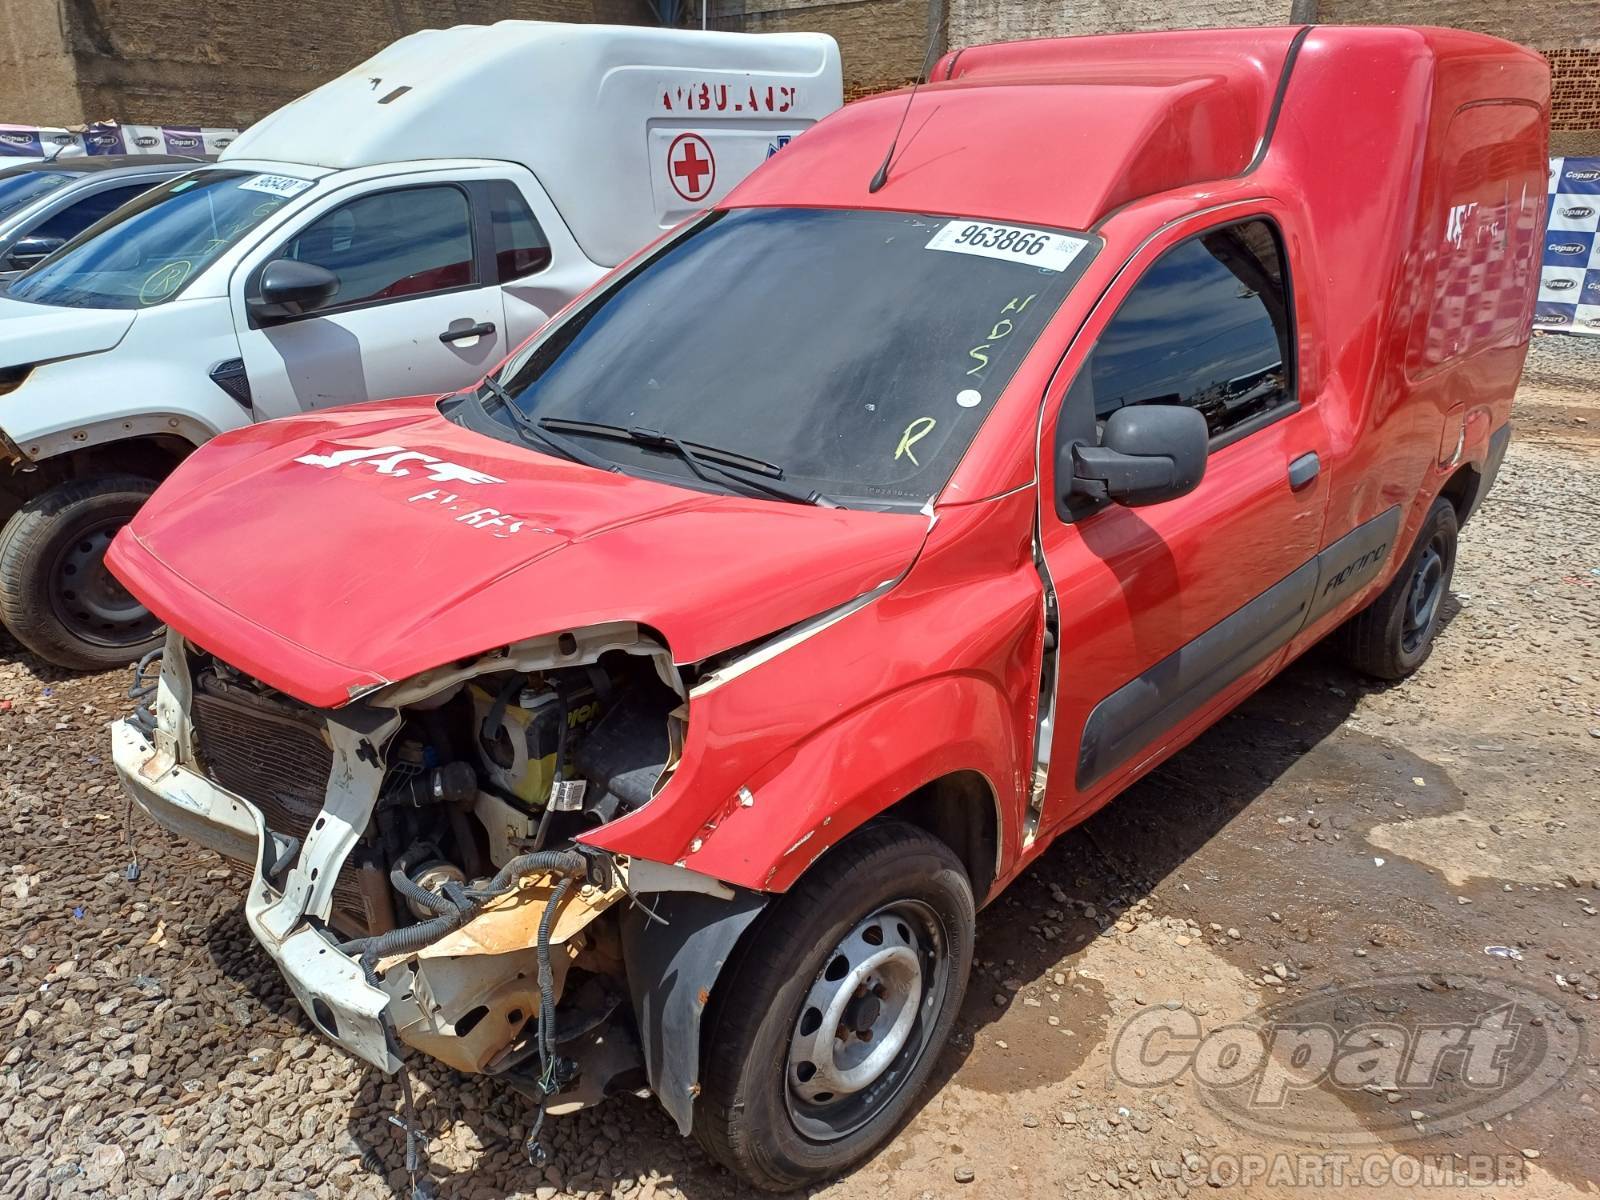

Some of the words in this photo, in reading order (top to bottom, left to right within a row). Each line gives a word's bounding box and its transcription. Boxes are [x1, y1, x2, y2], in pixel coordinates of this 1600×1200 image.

[169, 138, 195, 146] Copart
[1565, 170, 1599, 180] Copart
[955, 225, 1050, 256] 963866
[1548, 243, 1581, 253] Copart
[894, 416, 937, 467] R
